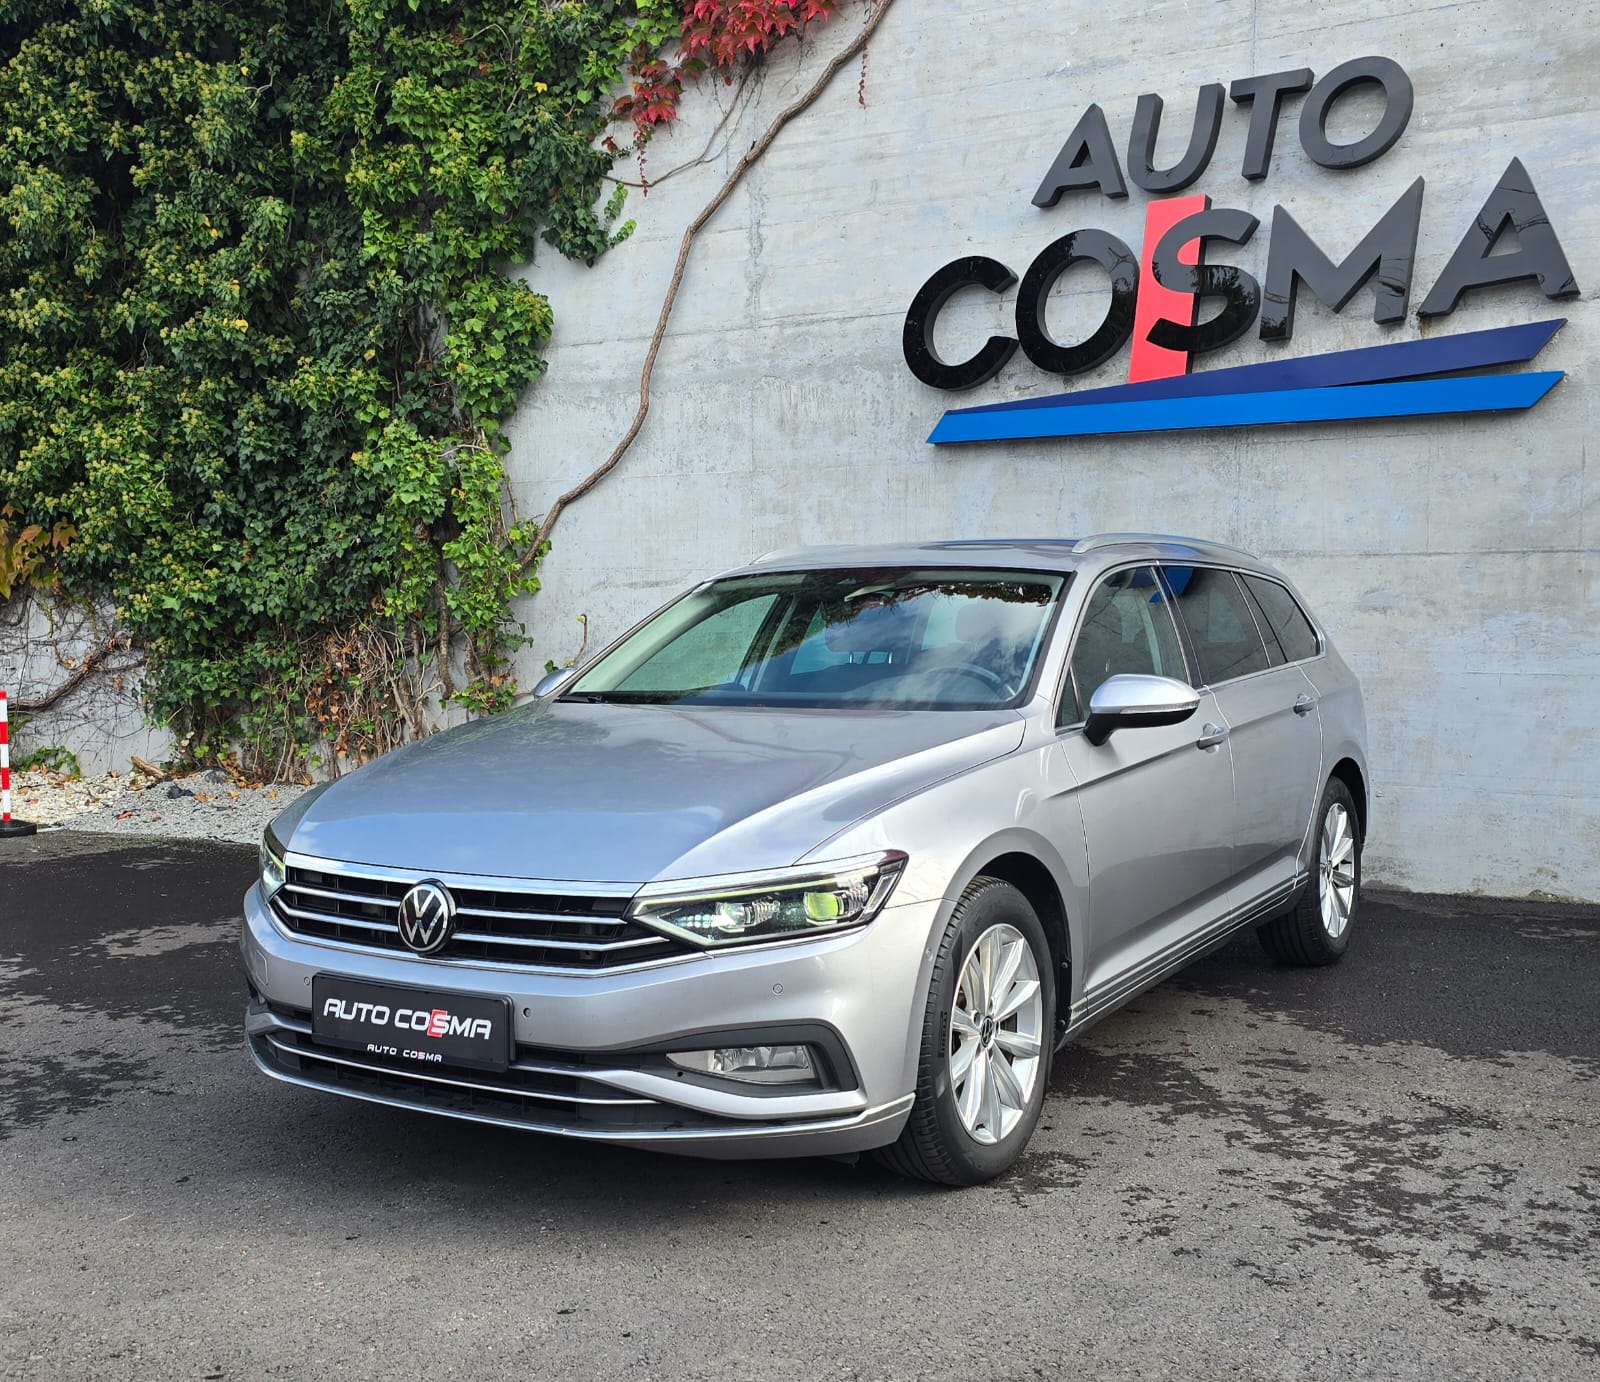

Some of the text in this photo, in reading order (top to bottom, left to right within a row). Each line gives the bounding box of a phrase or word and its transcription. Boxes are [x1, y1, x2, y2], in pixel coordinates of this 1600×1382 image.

[1030, 55, 1414, 209] AUTO
[902, 156, 1582, 391] COSMA
[401, 885, 447, 949] VW
[323, 998, 492, 1040] AUTO COSMA
[367, 1043, 443, 1063] AUTO COSMA
